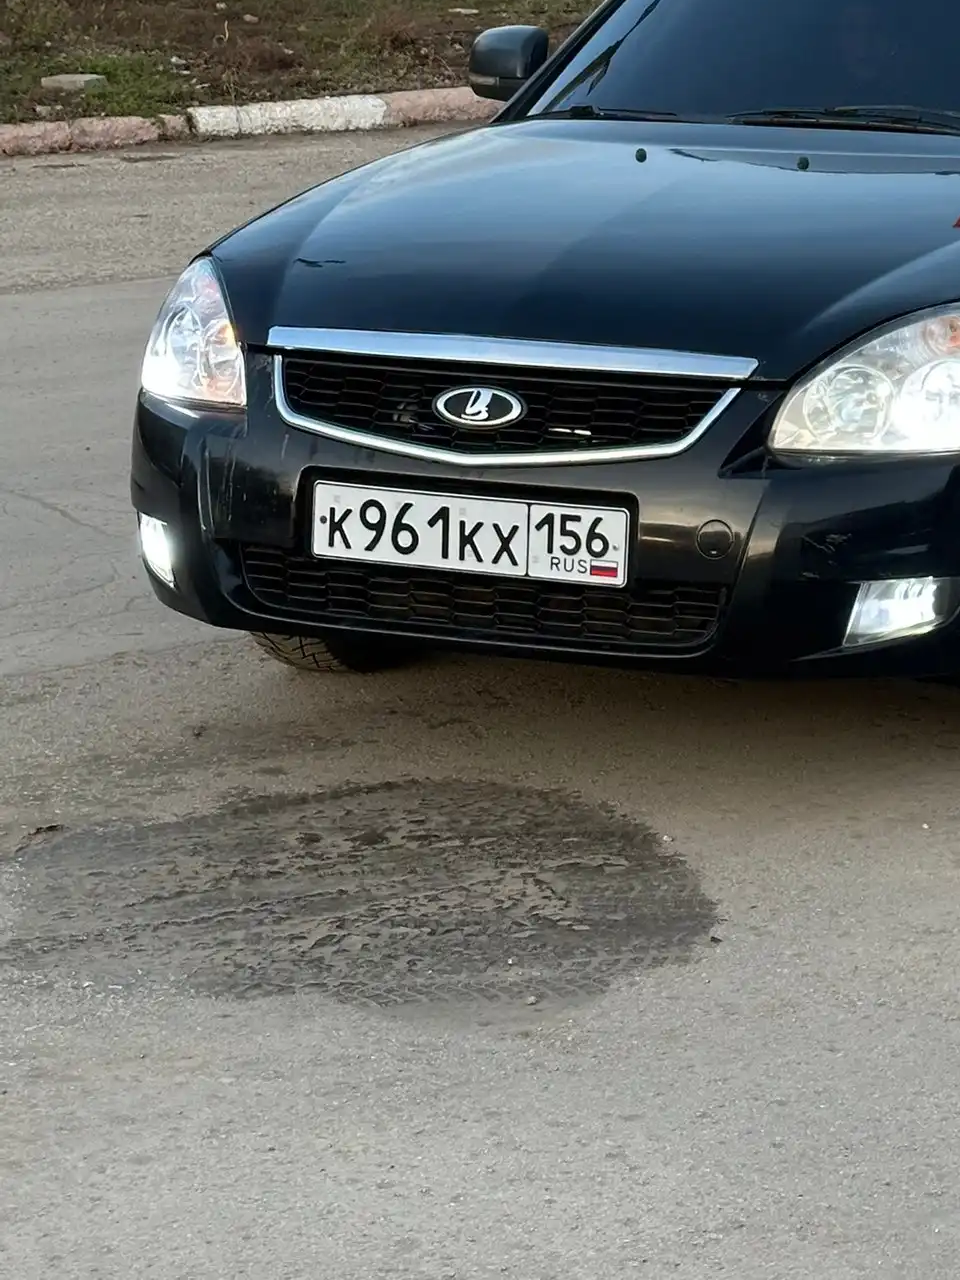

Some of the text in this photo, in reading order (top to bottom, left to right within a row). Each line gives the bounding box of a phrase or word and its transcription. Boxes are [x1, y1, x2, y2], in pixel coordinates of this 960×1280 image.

[328, 499, 609, 566] К961КХ 156
[550, 556, 588, 574] RUS
